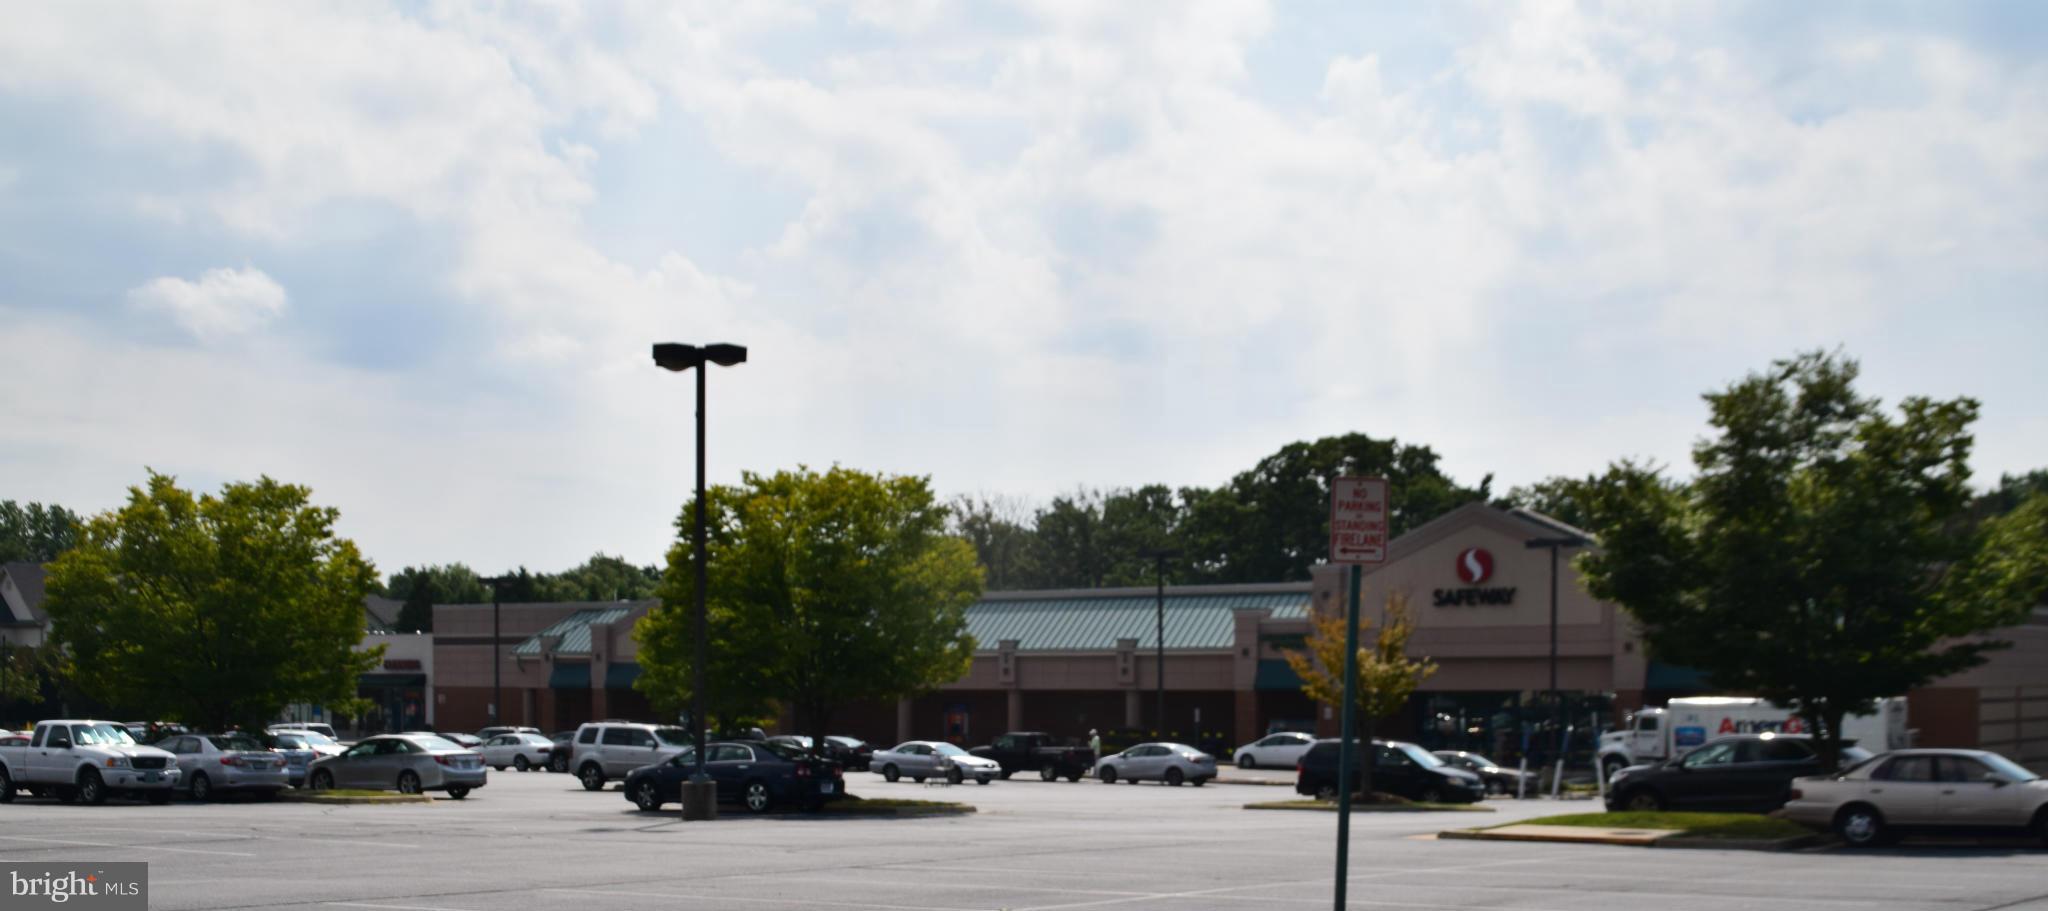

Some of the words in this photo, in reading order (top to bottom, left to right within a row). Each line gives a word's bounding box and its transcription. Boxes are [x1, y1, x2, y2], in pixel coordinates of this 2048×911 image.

[1352, 487, 1368, 499] NO
[1338, 499, 1381, 512] PARKING
[1335, 519, 1385, 532] STANDING
[1433, 587, 1517, 607] SAFEWAY
[1719, 716, 1827, 735] AmeriG
